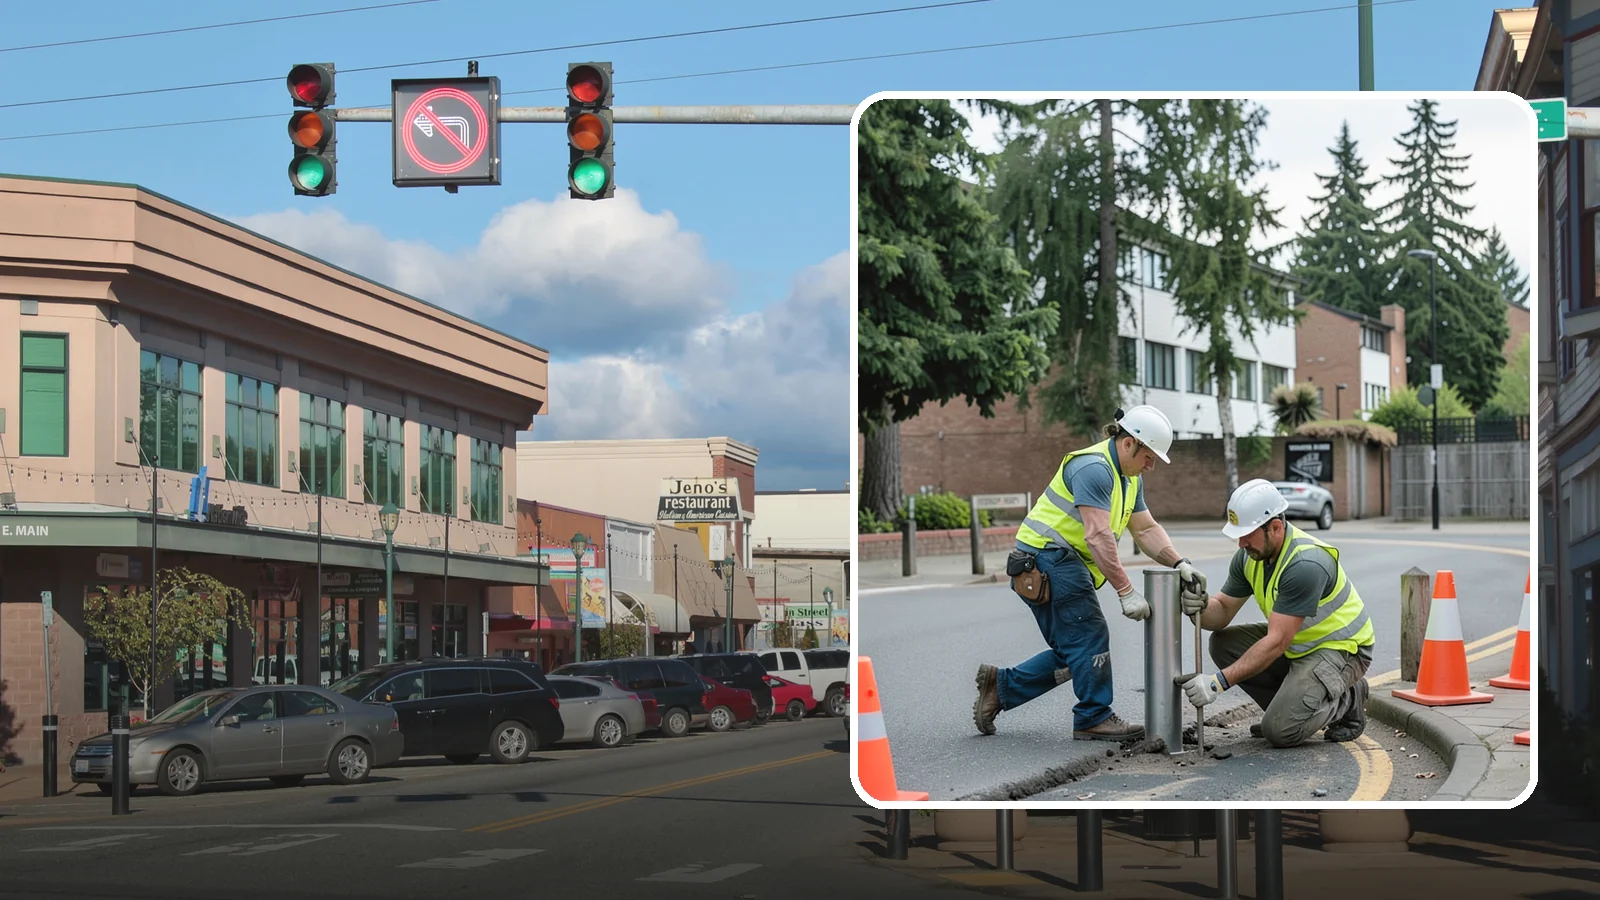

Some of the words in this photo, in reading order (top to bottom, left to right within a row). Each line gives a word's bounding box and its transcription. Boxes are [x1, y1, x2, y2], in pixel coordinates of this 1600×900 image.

[670, 480, 727, 494] Jeno's
[665, 496, 731, 509] restaurant
[659, 510, 682, 519] Italian
[686, 510, 714, 519] American
[715, 509, 737, 519] Cuisine
[2, 525, 13, 536] E.
[15, 525, 49, 536] MAIN
[797, 607, 828, 617] Street
[791, 619, 824, 627] lass
